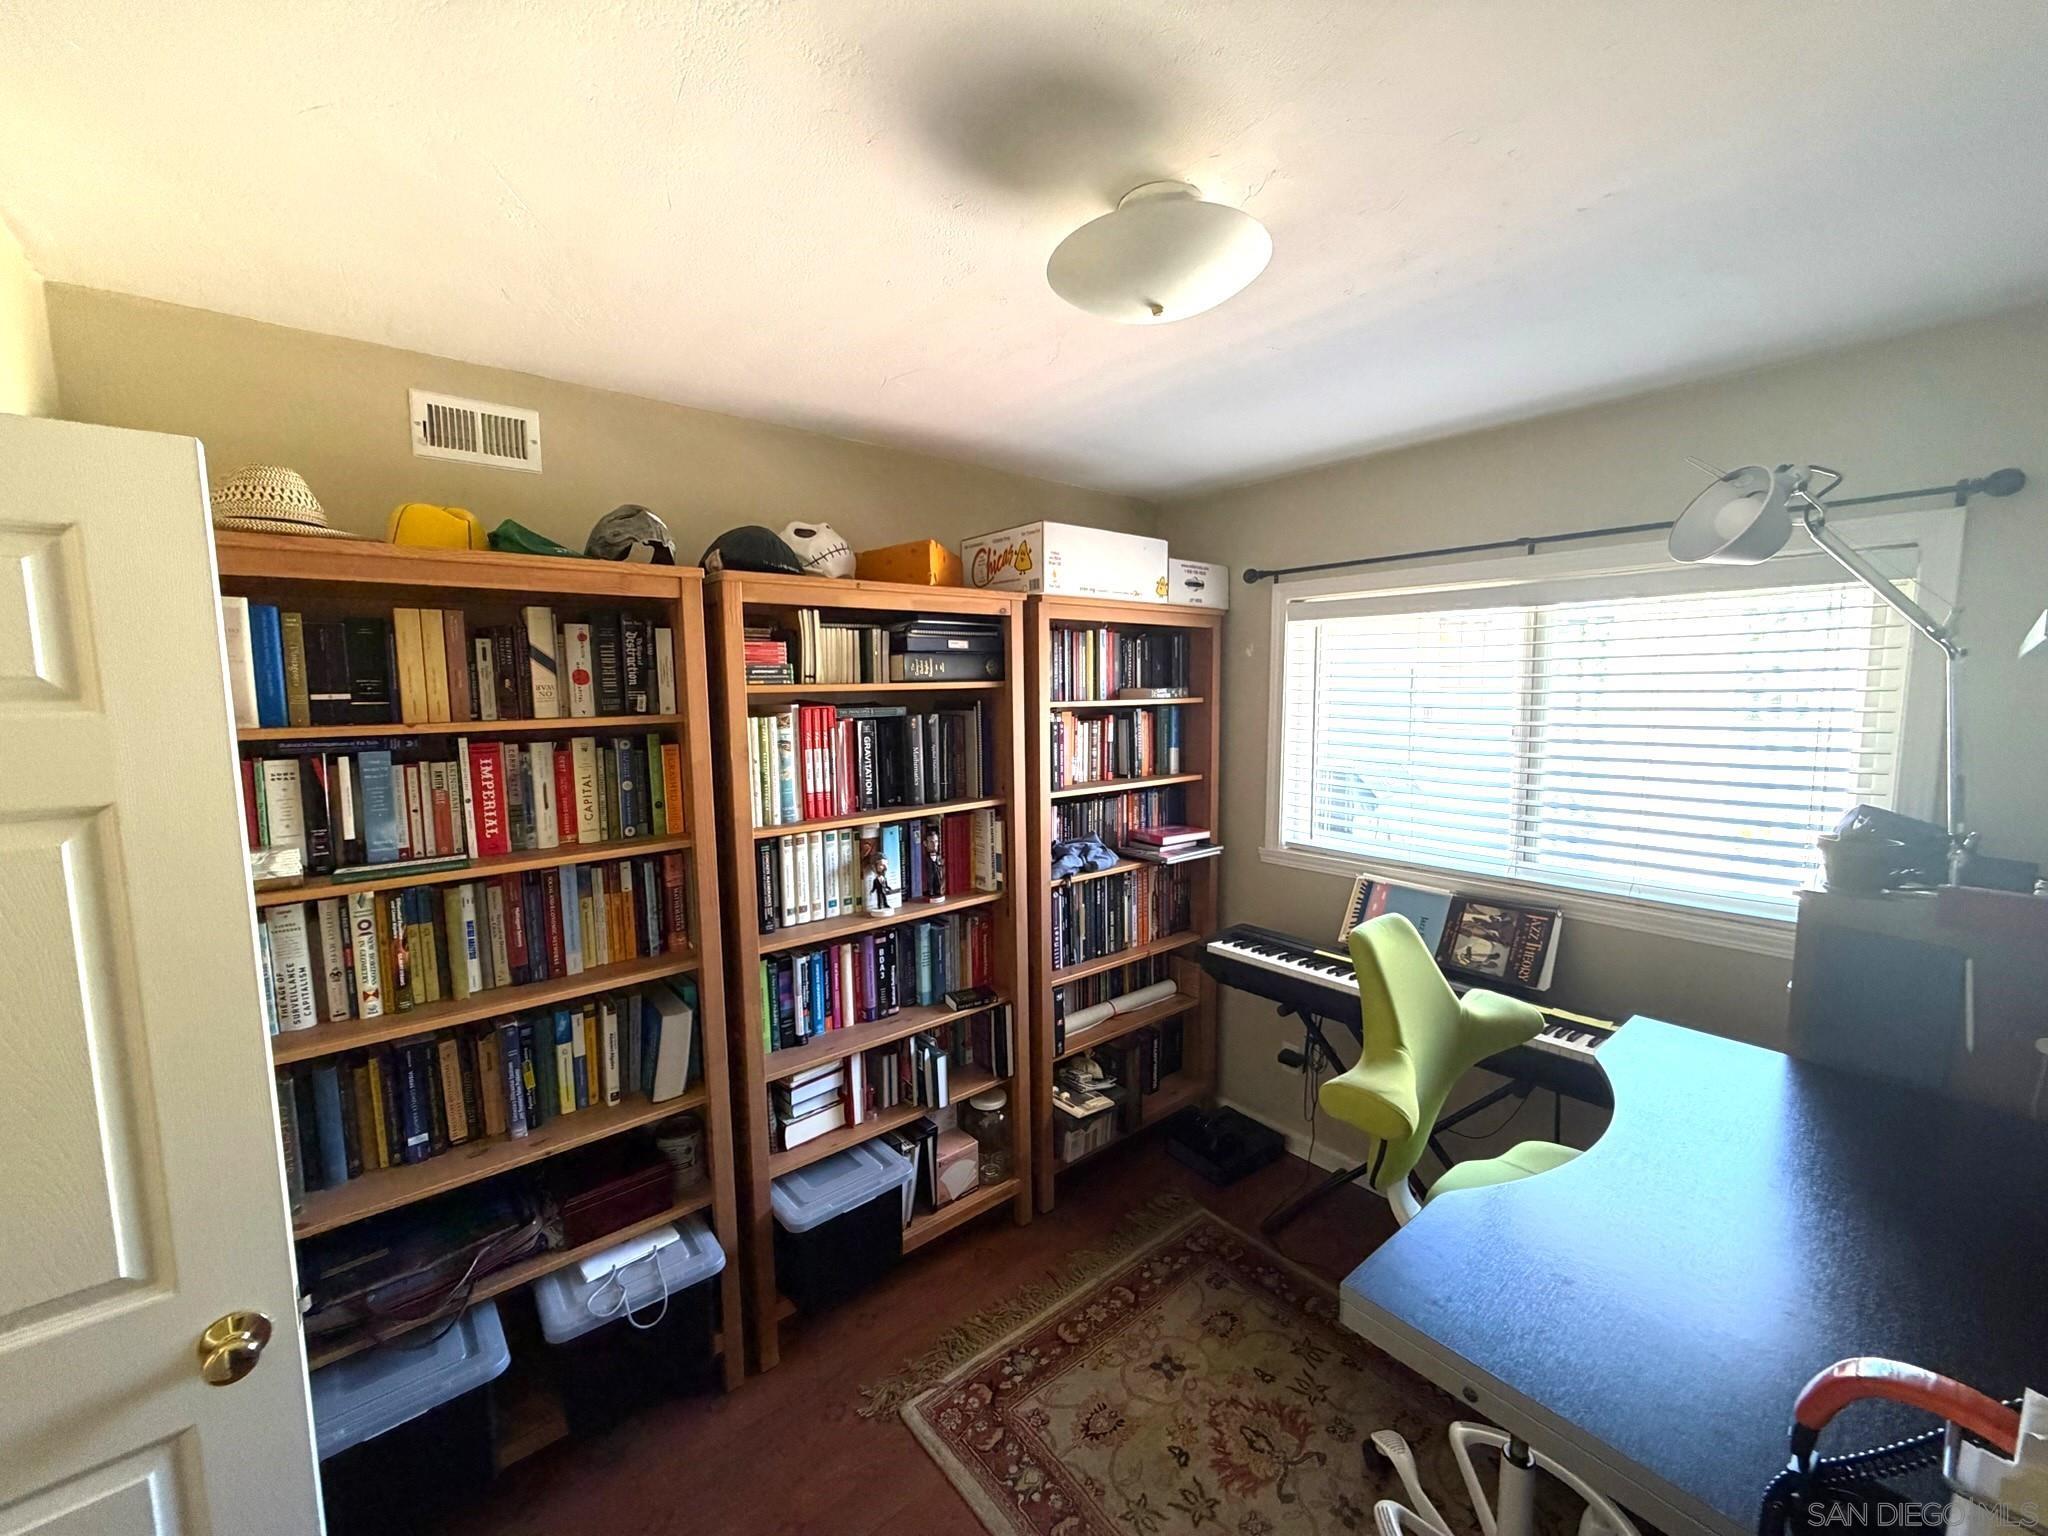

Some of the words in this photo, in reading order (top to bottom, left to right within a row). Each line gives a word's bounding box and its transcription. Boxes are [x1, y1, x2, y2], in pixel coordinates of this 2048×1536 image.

[625, 631, 639, 686] Destruction
[863, 736, 873, 795] GRAVITATION
[480, 759, 498, 838] IMPERIAL
[584, 774, 594, 821] CAPITAL
[1526, 914, 1549, 940] JAZZ
[276, 973, 283, 982] OF
[1518, 941, 1543, 982] THEORY
[278, 985, 286, 1003] AGE
[287, 963, 301, 1025] SURVEILLANCE
[298, 966, 312, 1017] CAPITALISM
